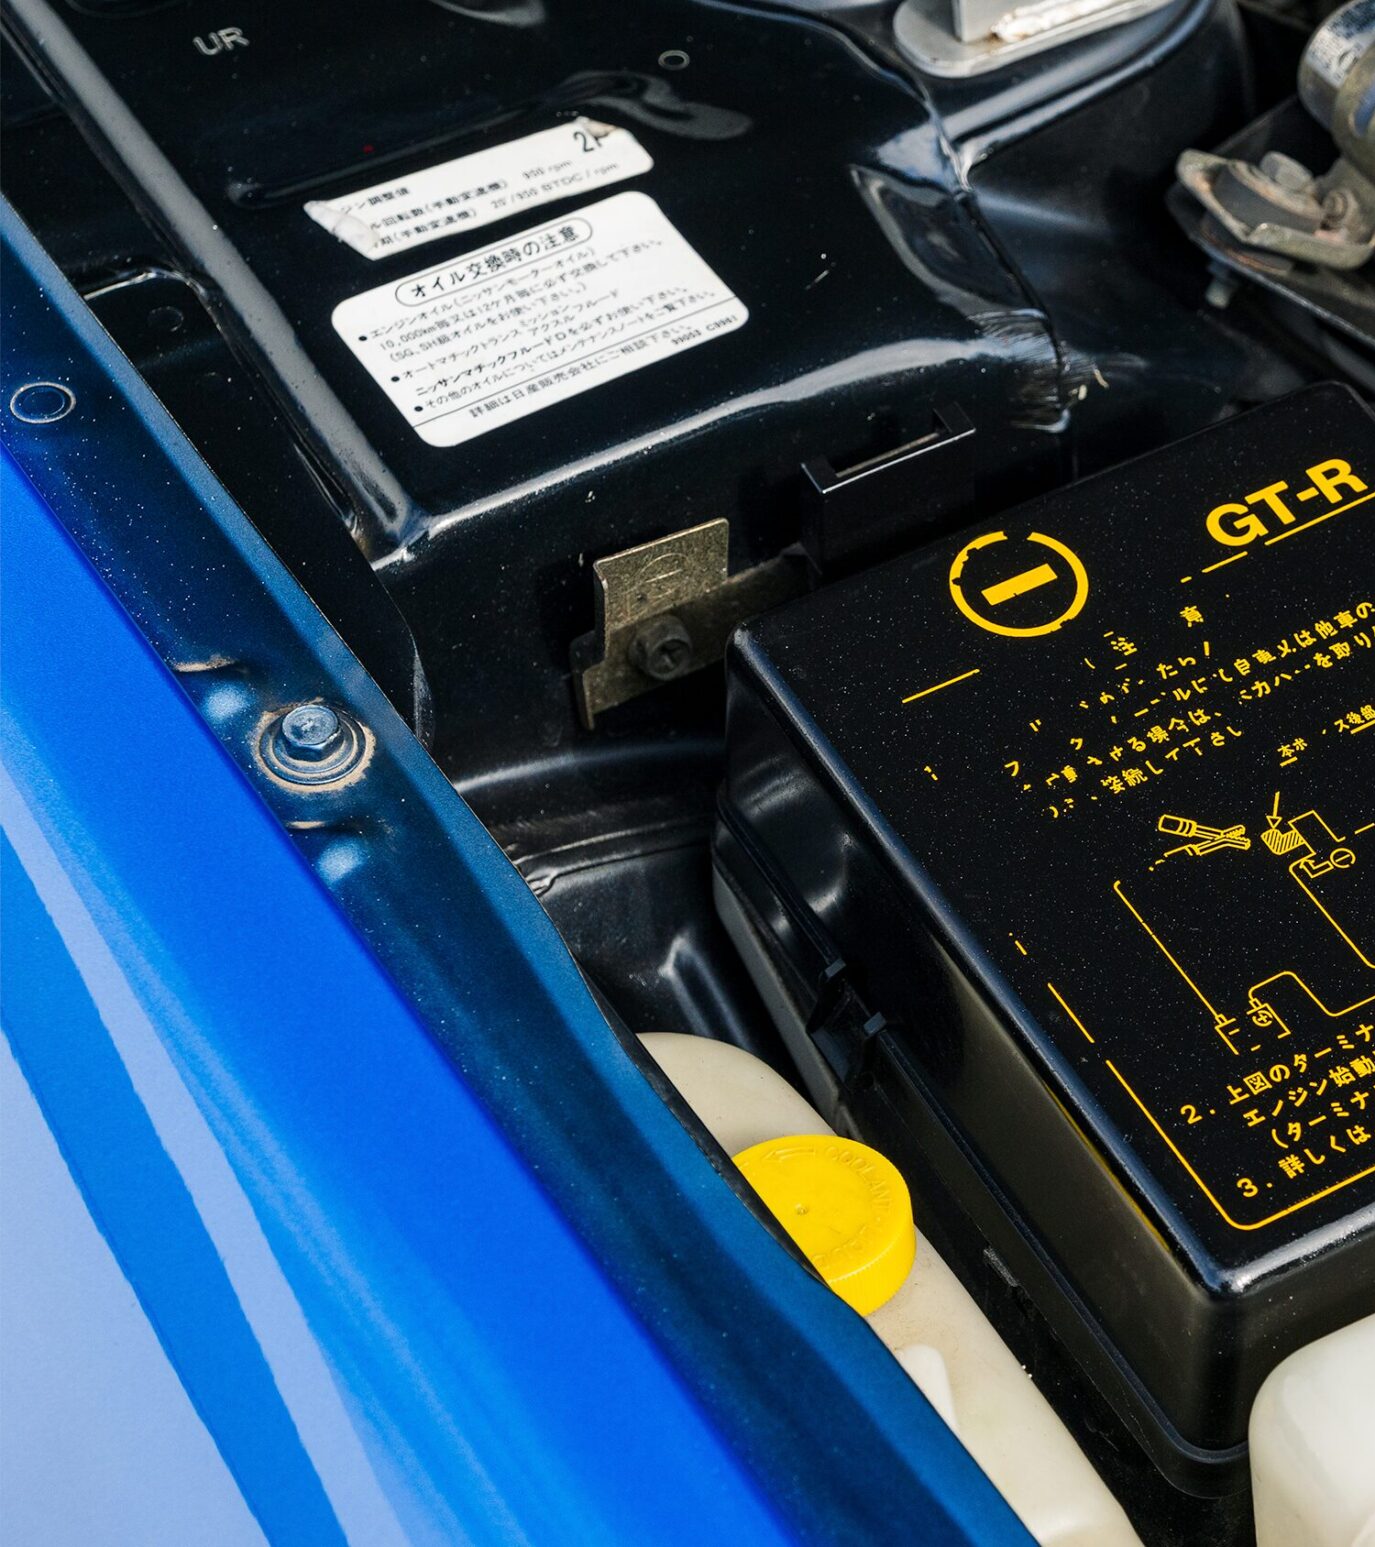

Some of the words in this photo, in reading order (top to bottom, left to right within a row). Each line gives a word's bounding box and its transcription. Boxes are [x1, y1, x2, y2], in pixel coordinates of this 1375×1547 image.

[193, 27, 249, 55] UR
[411, 225, 579, 298] オイル交換時の注意
[1206, 458, 1368, 546] GT-R
